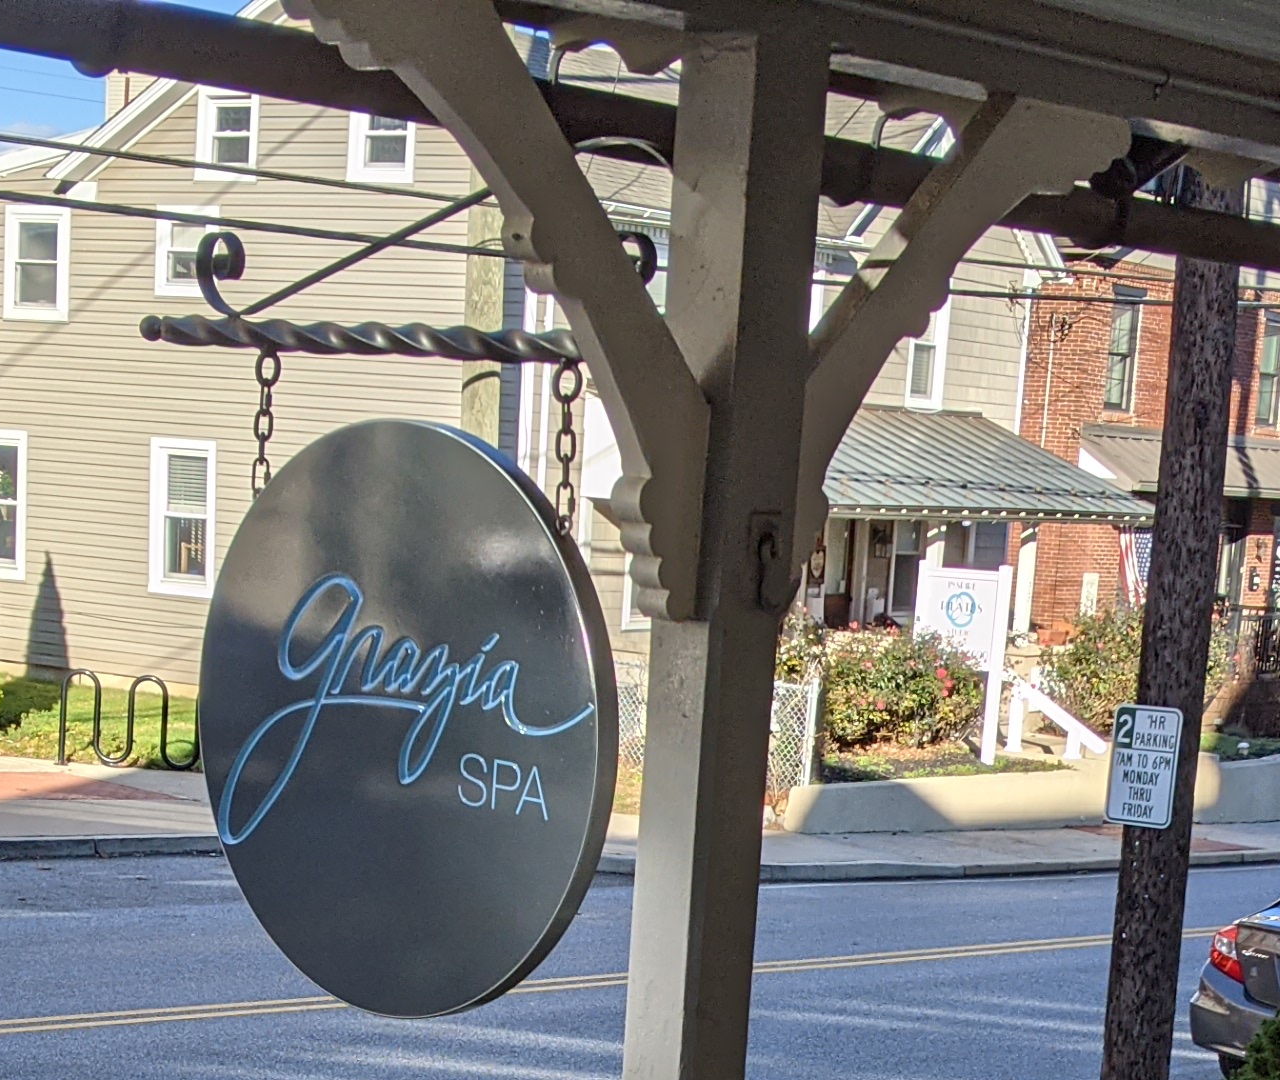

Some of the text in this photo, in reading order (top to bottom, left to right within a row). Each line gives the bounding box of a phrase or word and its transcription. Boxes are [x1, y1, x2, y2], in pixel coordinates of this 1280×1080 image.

[940, 600, 982, 613] PILATES
[1117, 714, 1167, 743] 2 HR
[1134, 731, 1175, 750] PARKING
[1116, 751, 1172, 772] 7AM TO 6PM
[456, 752, 549, 821] SPA
[1122, 769, 1161, 787] MONDAY
[1128, 786, 1152, 803] THRU
[1122, 802, 1154, 819] FRIDAY
